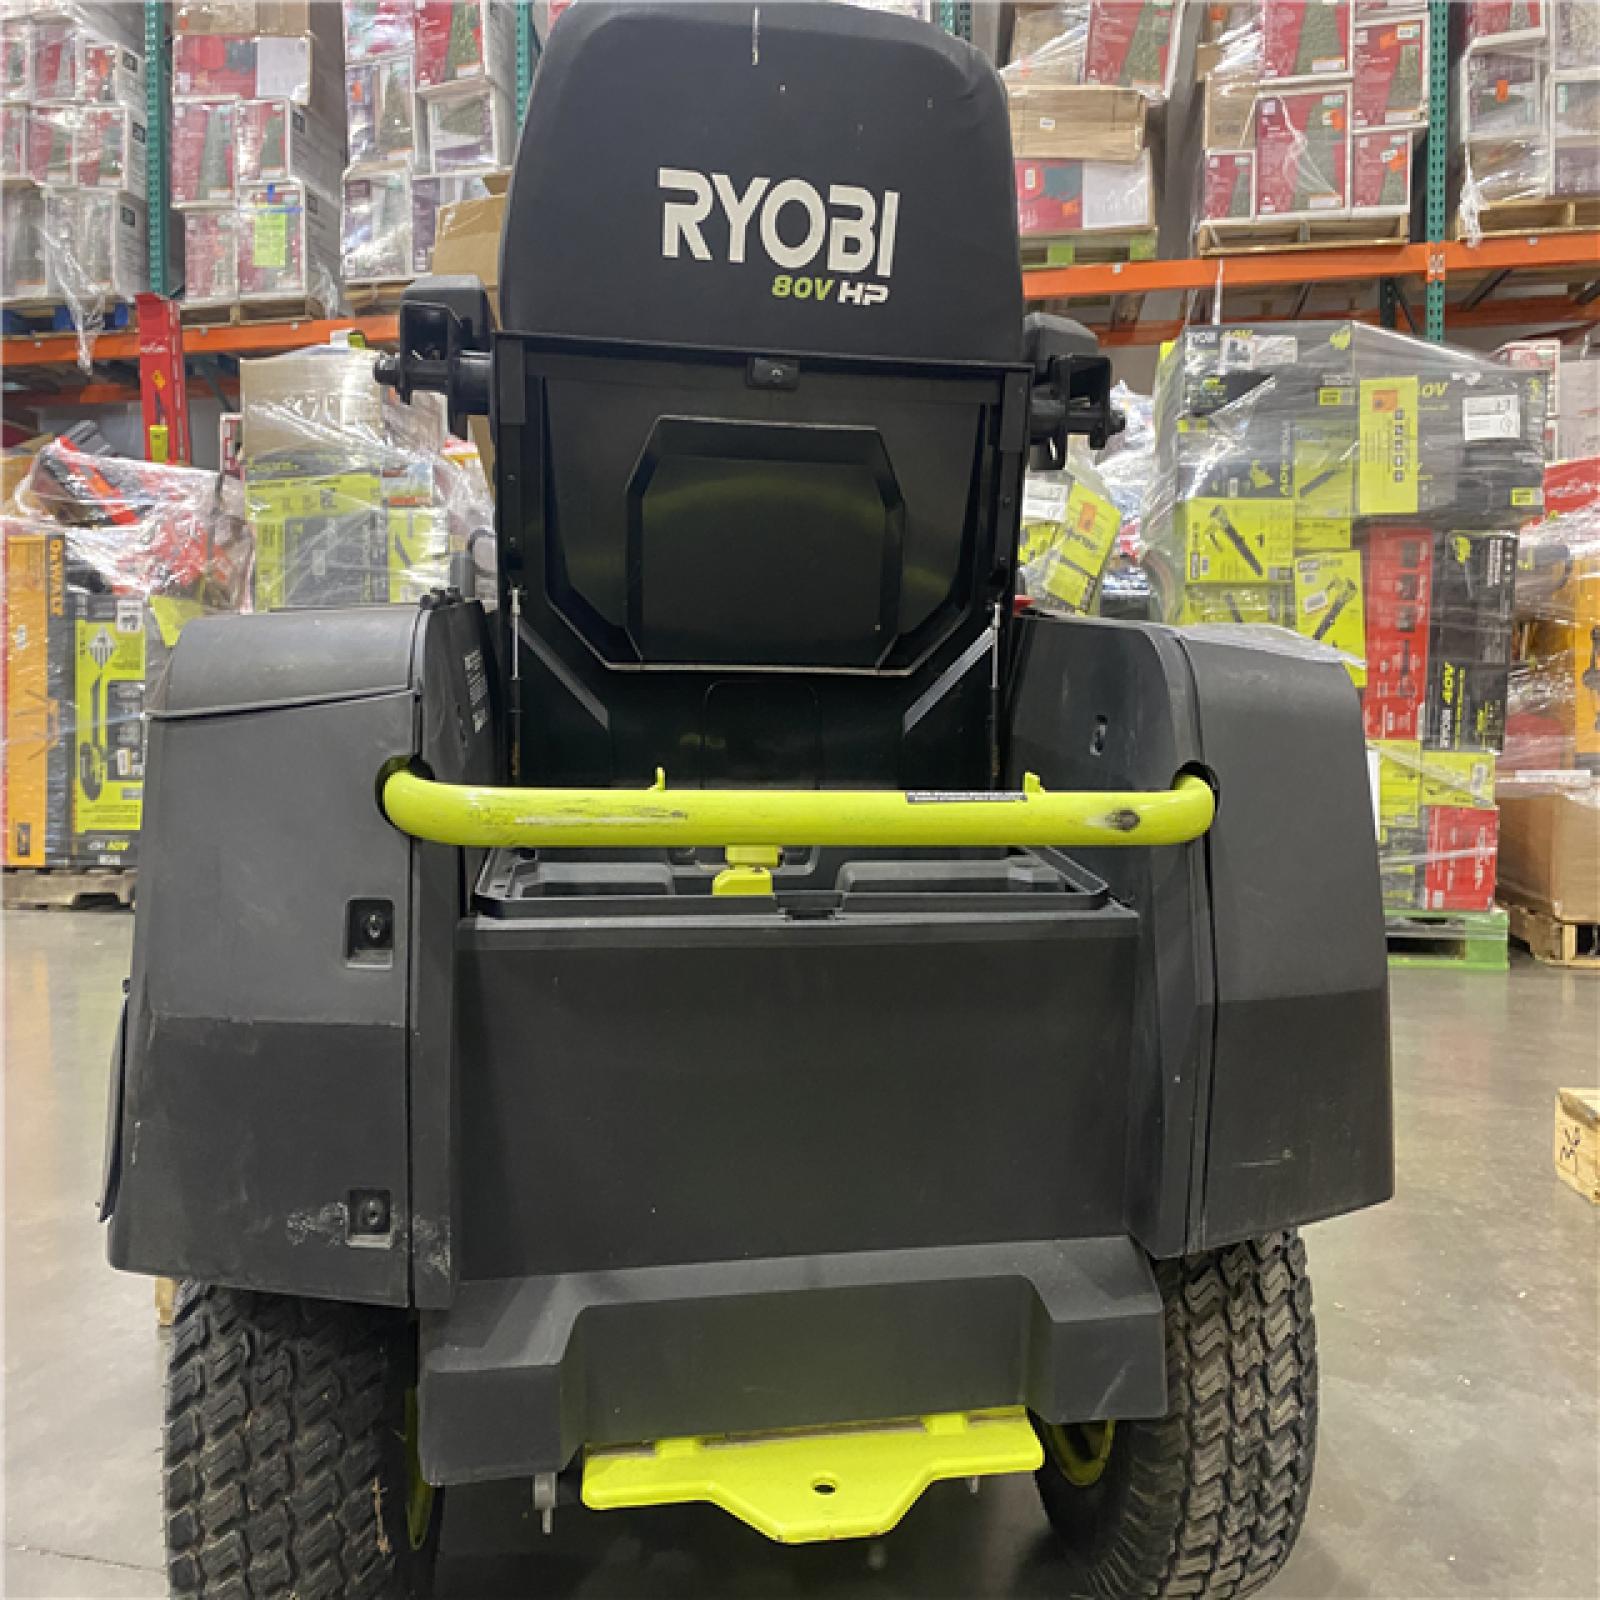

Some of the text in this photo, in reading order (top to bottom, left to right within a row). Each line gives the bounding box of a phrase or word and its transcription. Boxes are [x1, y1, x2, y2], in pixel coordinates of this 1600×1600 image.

[658, 167, 900, 278] RYOBI
[772, 275, 889, 306] 80V HP
